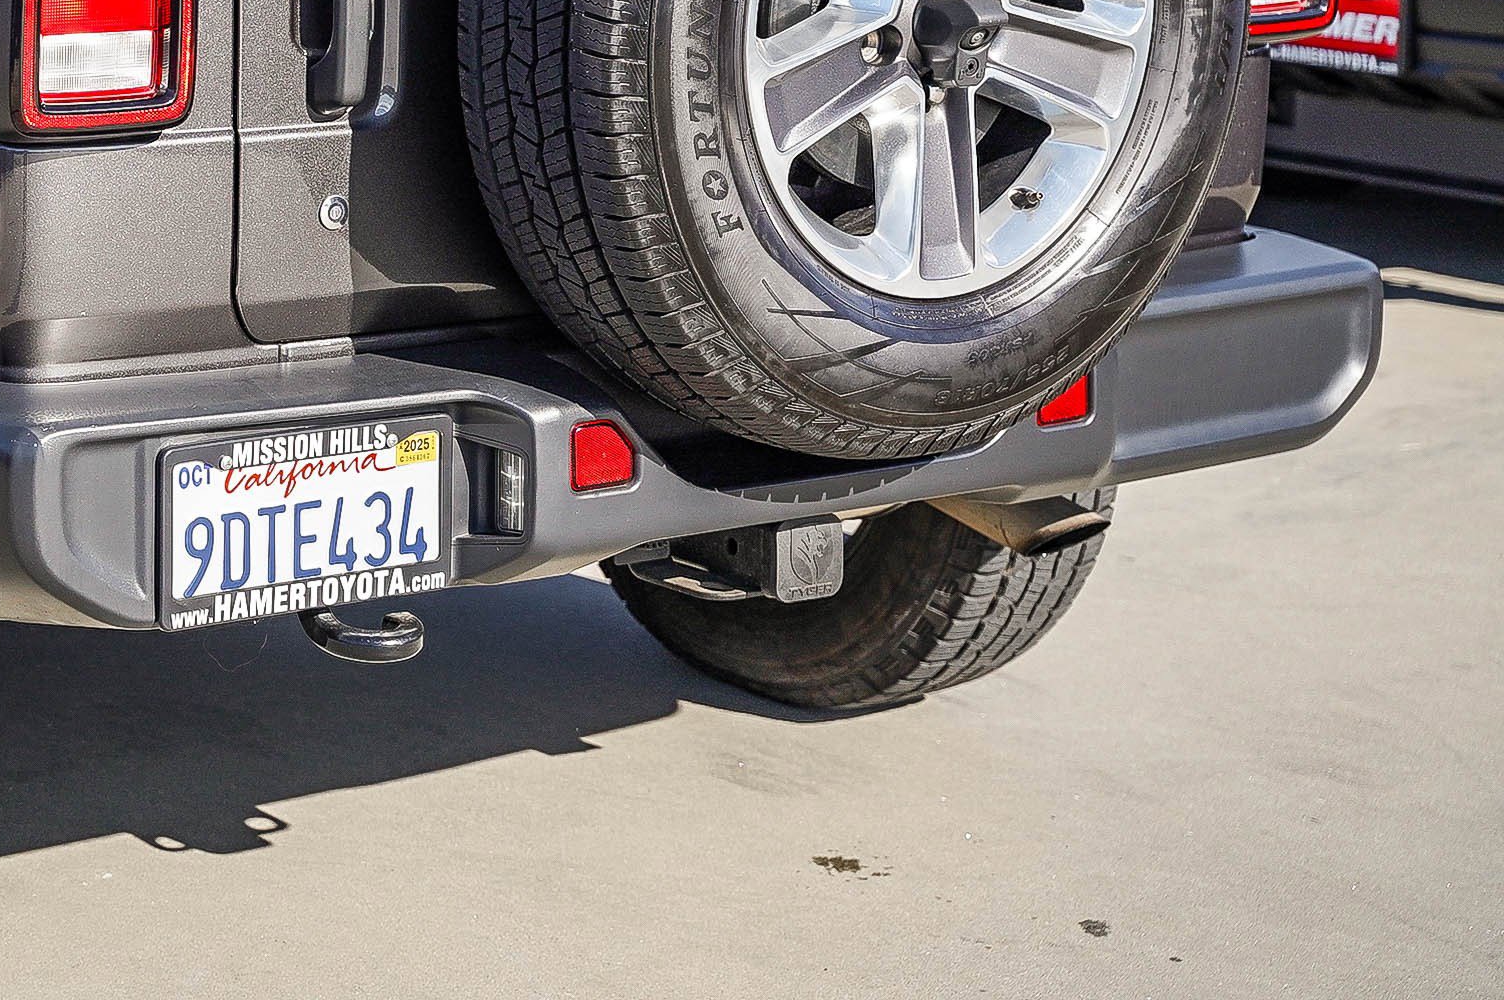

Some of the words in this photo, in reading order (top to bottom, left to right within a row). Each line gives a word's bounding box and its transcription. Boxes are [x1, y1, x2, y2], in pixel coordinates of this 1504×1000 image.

[1323, 10, 1400, 47] MER
[232, 431, 324, 469] MISSION
[329, 423, 388, 455] HILLS
[403, 437, 430, 453] 2025
[178, 463, 214, 490] OCT
[224, 452, 396, 498] California
[183, 486, 428, 599] 9DTE434
[170, 567, 446, 630] www.HAMERTOYOTA.com
